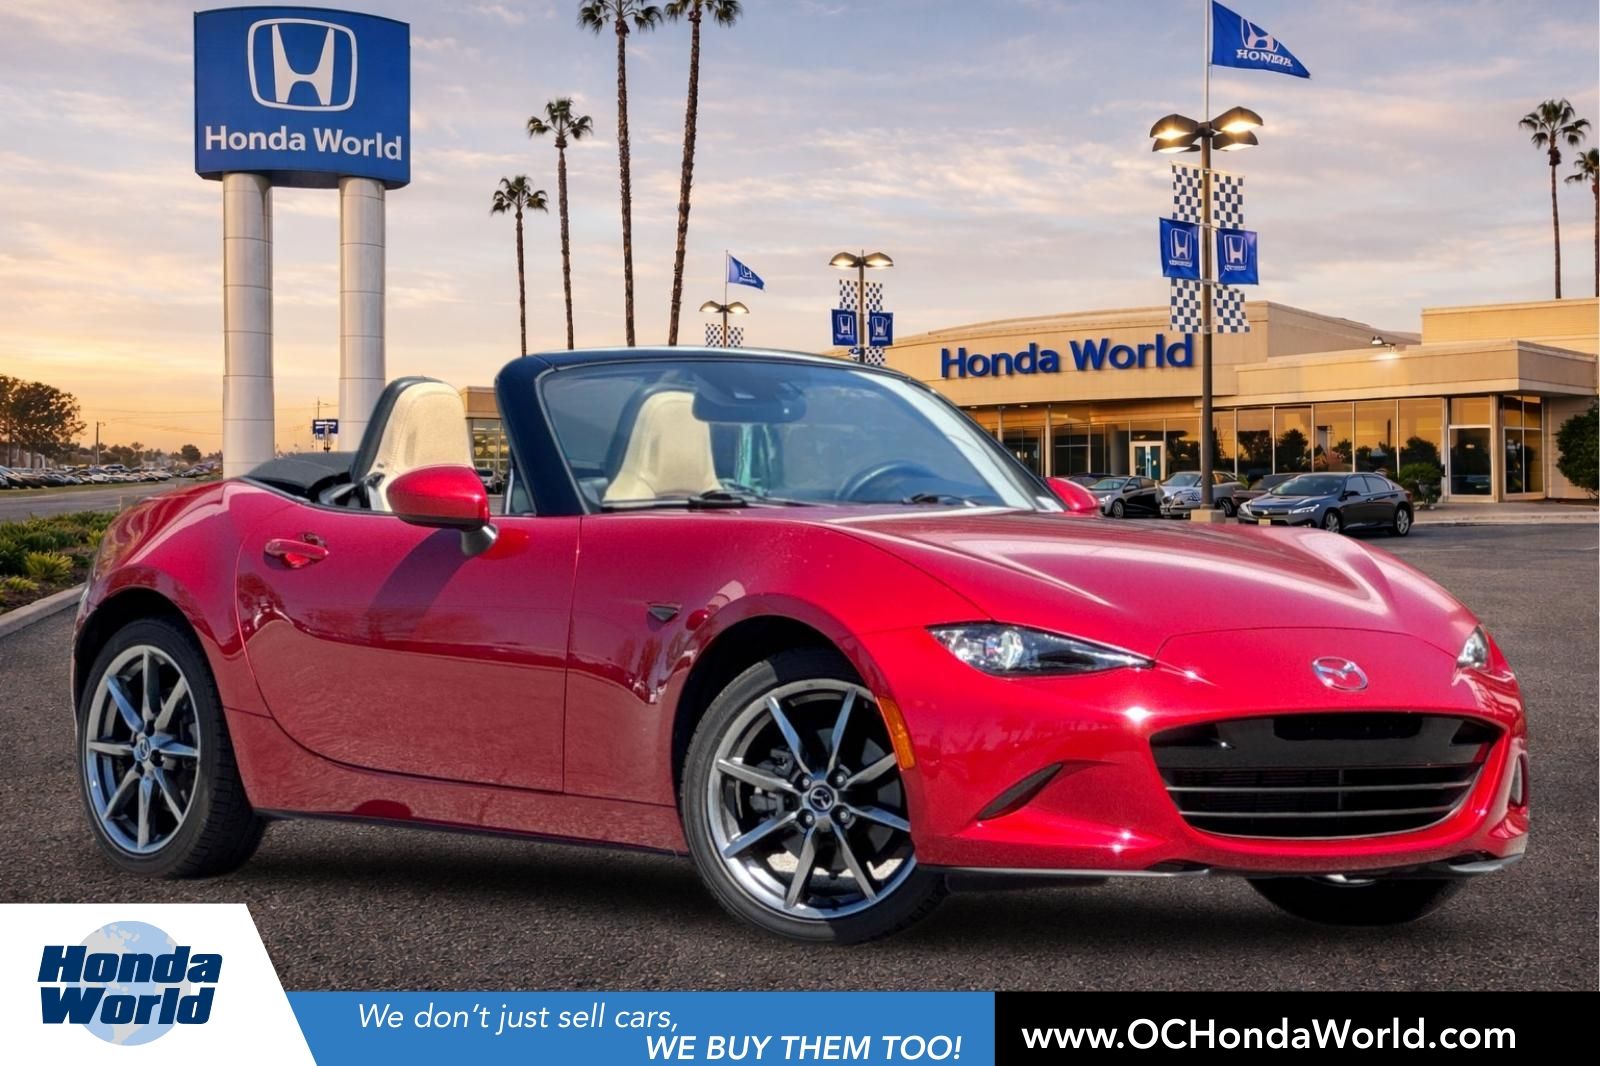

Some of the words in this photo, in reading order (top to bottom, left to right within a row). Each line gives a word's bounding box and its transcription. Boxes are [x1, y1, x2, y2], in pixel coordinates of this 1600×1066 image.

[205, 125, 306, 151] Honda
[313, 127, 402, 160] World
[941, 342, 1060, 377] Honda
[1070, 334, 1193, 370] World
